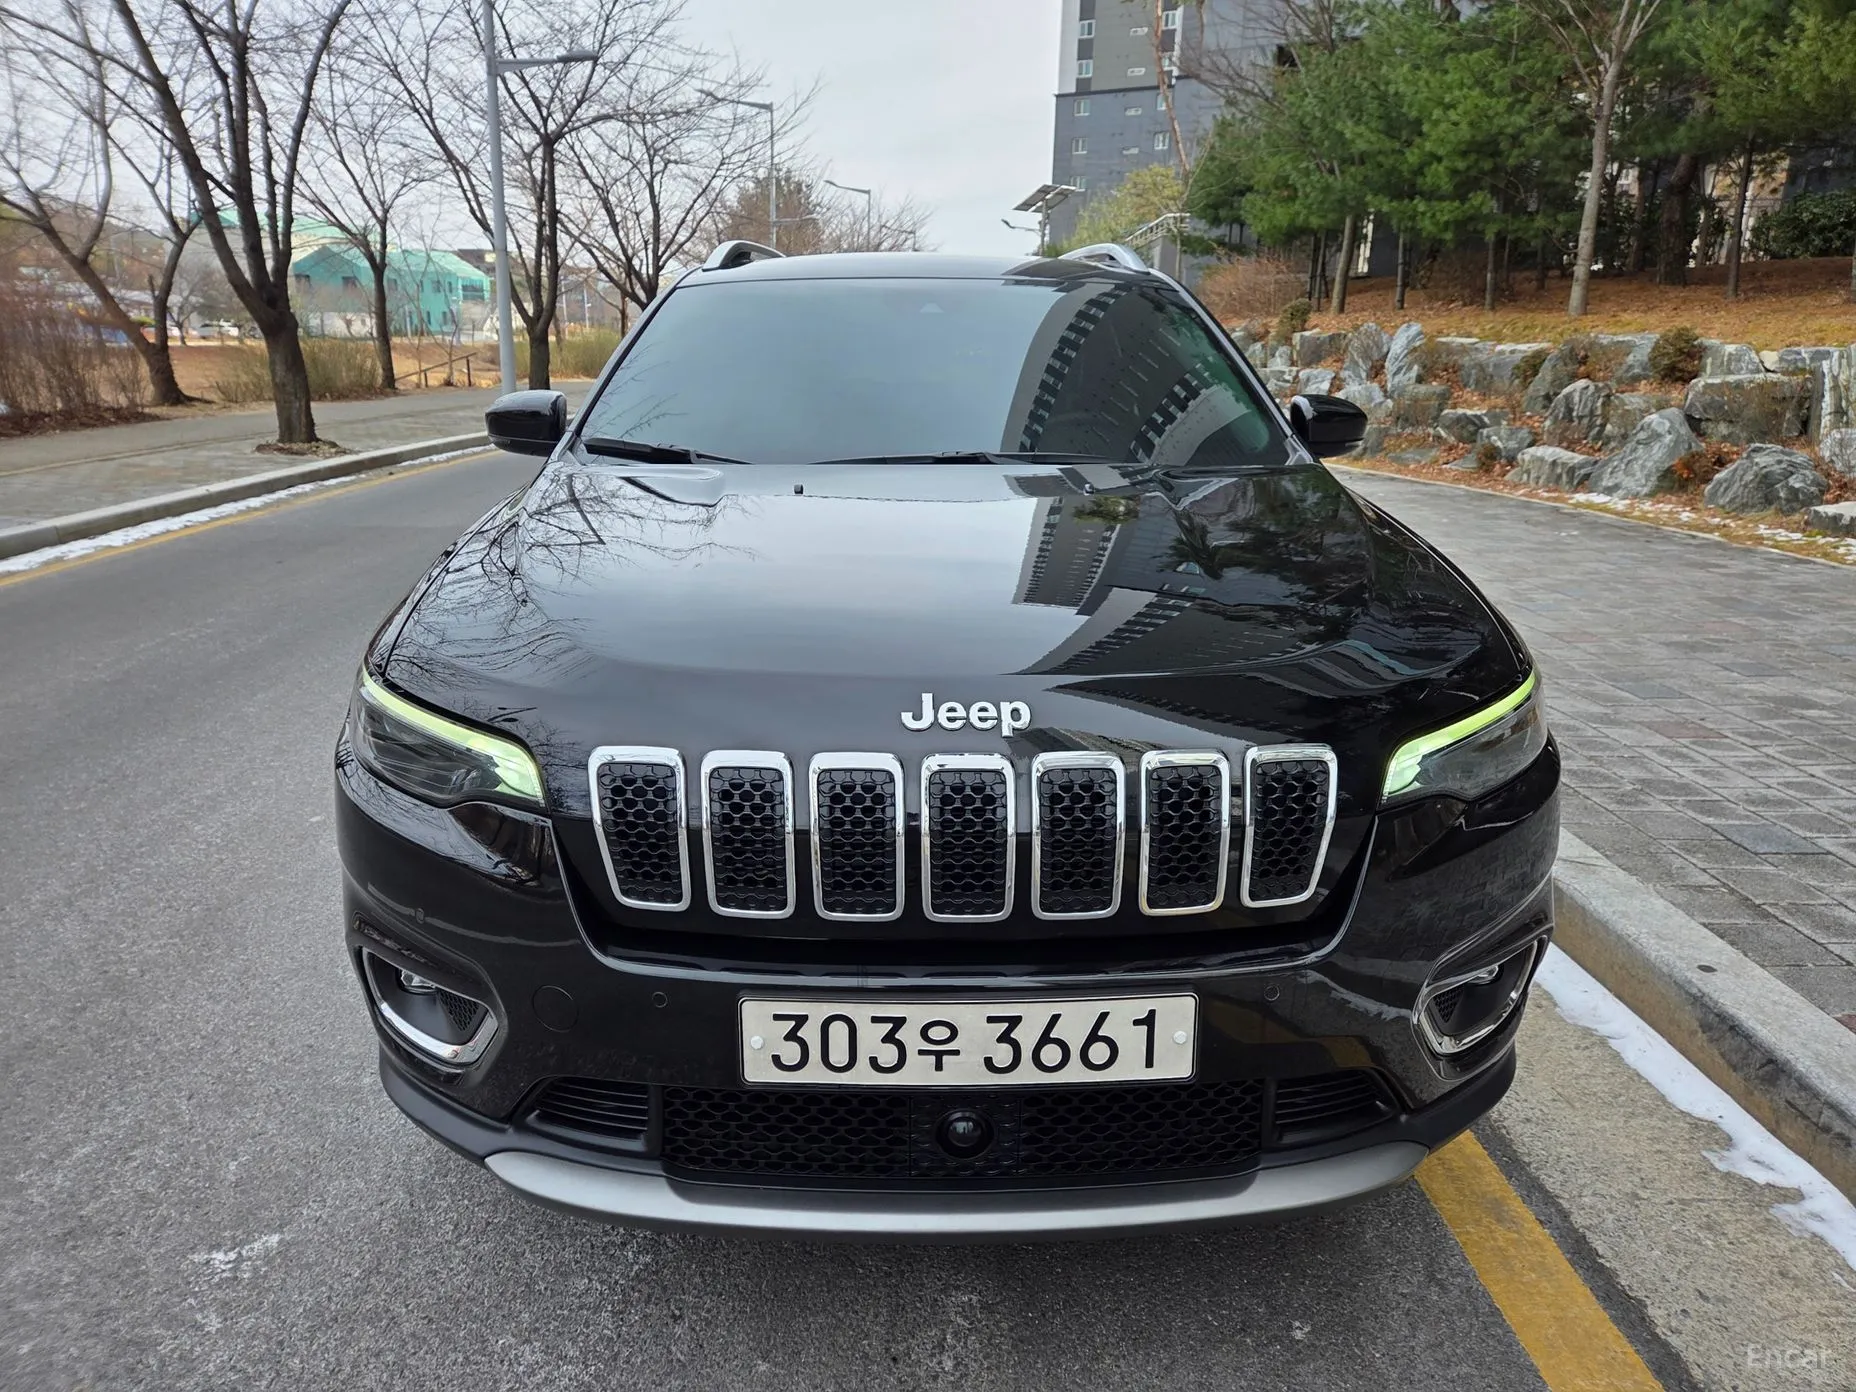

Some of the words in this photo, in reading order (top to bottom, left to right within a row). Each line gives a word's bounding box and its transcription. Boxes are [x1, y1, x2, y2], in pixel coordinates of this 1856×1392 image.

[900, 692, 1031, 738] Jeep
[771, 1013, 960, 1074] 303우
[983, 1008, 1156, 1074] 3661
